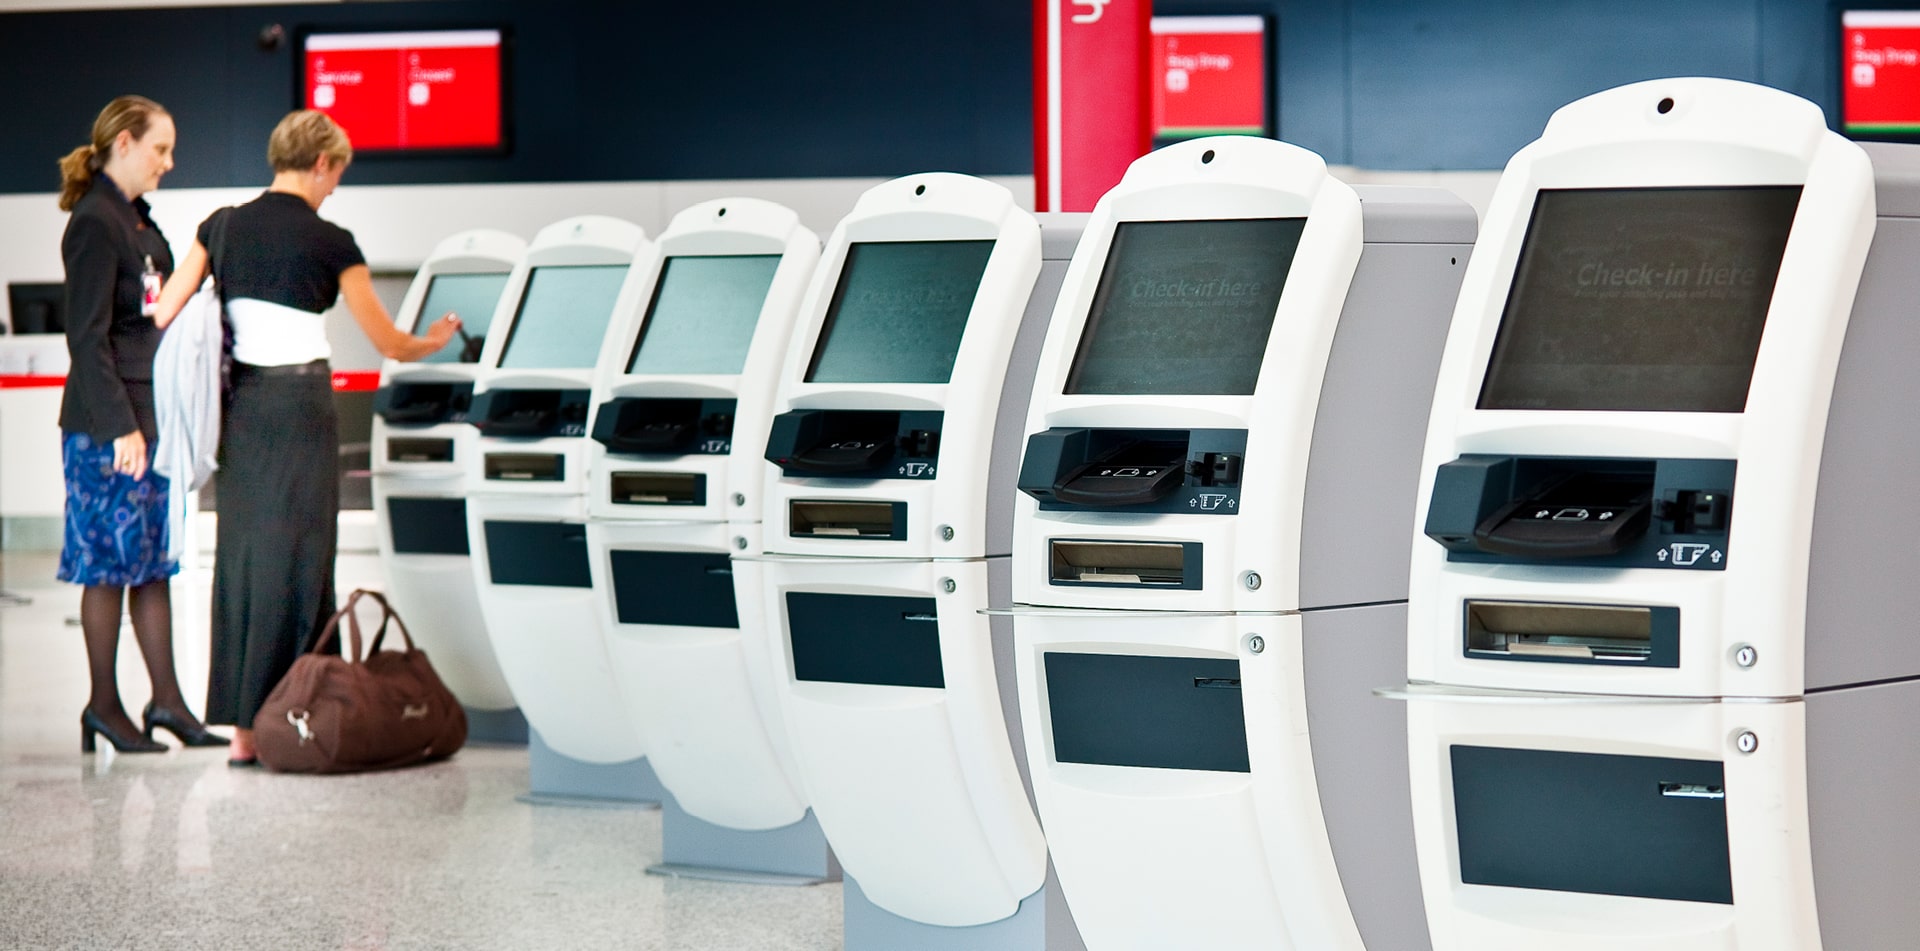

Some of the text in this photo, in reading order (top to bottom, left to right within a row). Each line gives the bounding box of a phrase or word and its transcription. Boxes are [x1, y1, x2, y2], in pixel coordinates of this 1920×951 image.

[1166, 52, 1232, 72] Bag Drop
[1576, 261, 1757, 286] Check-in here
[1131, 279, 1263, 298] Check-in here
